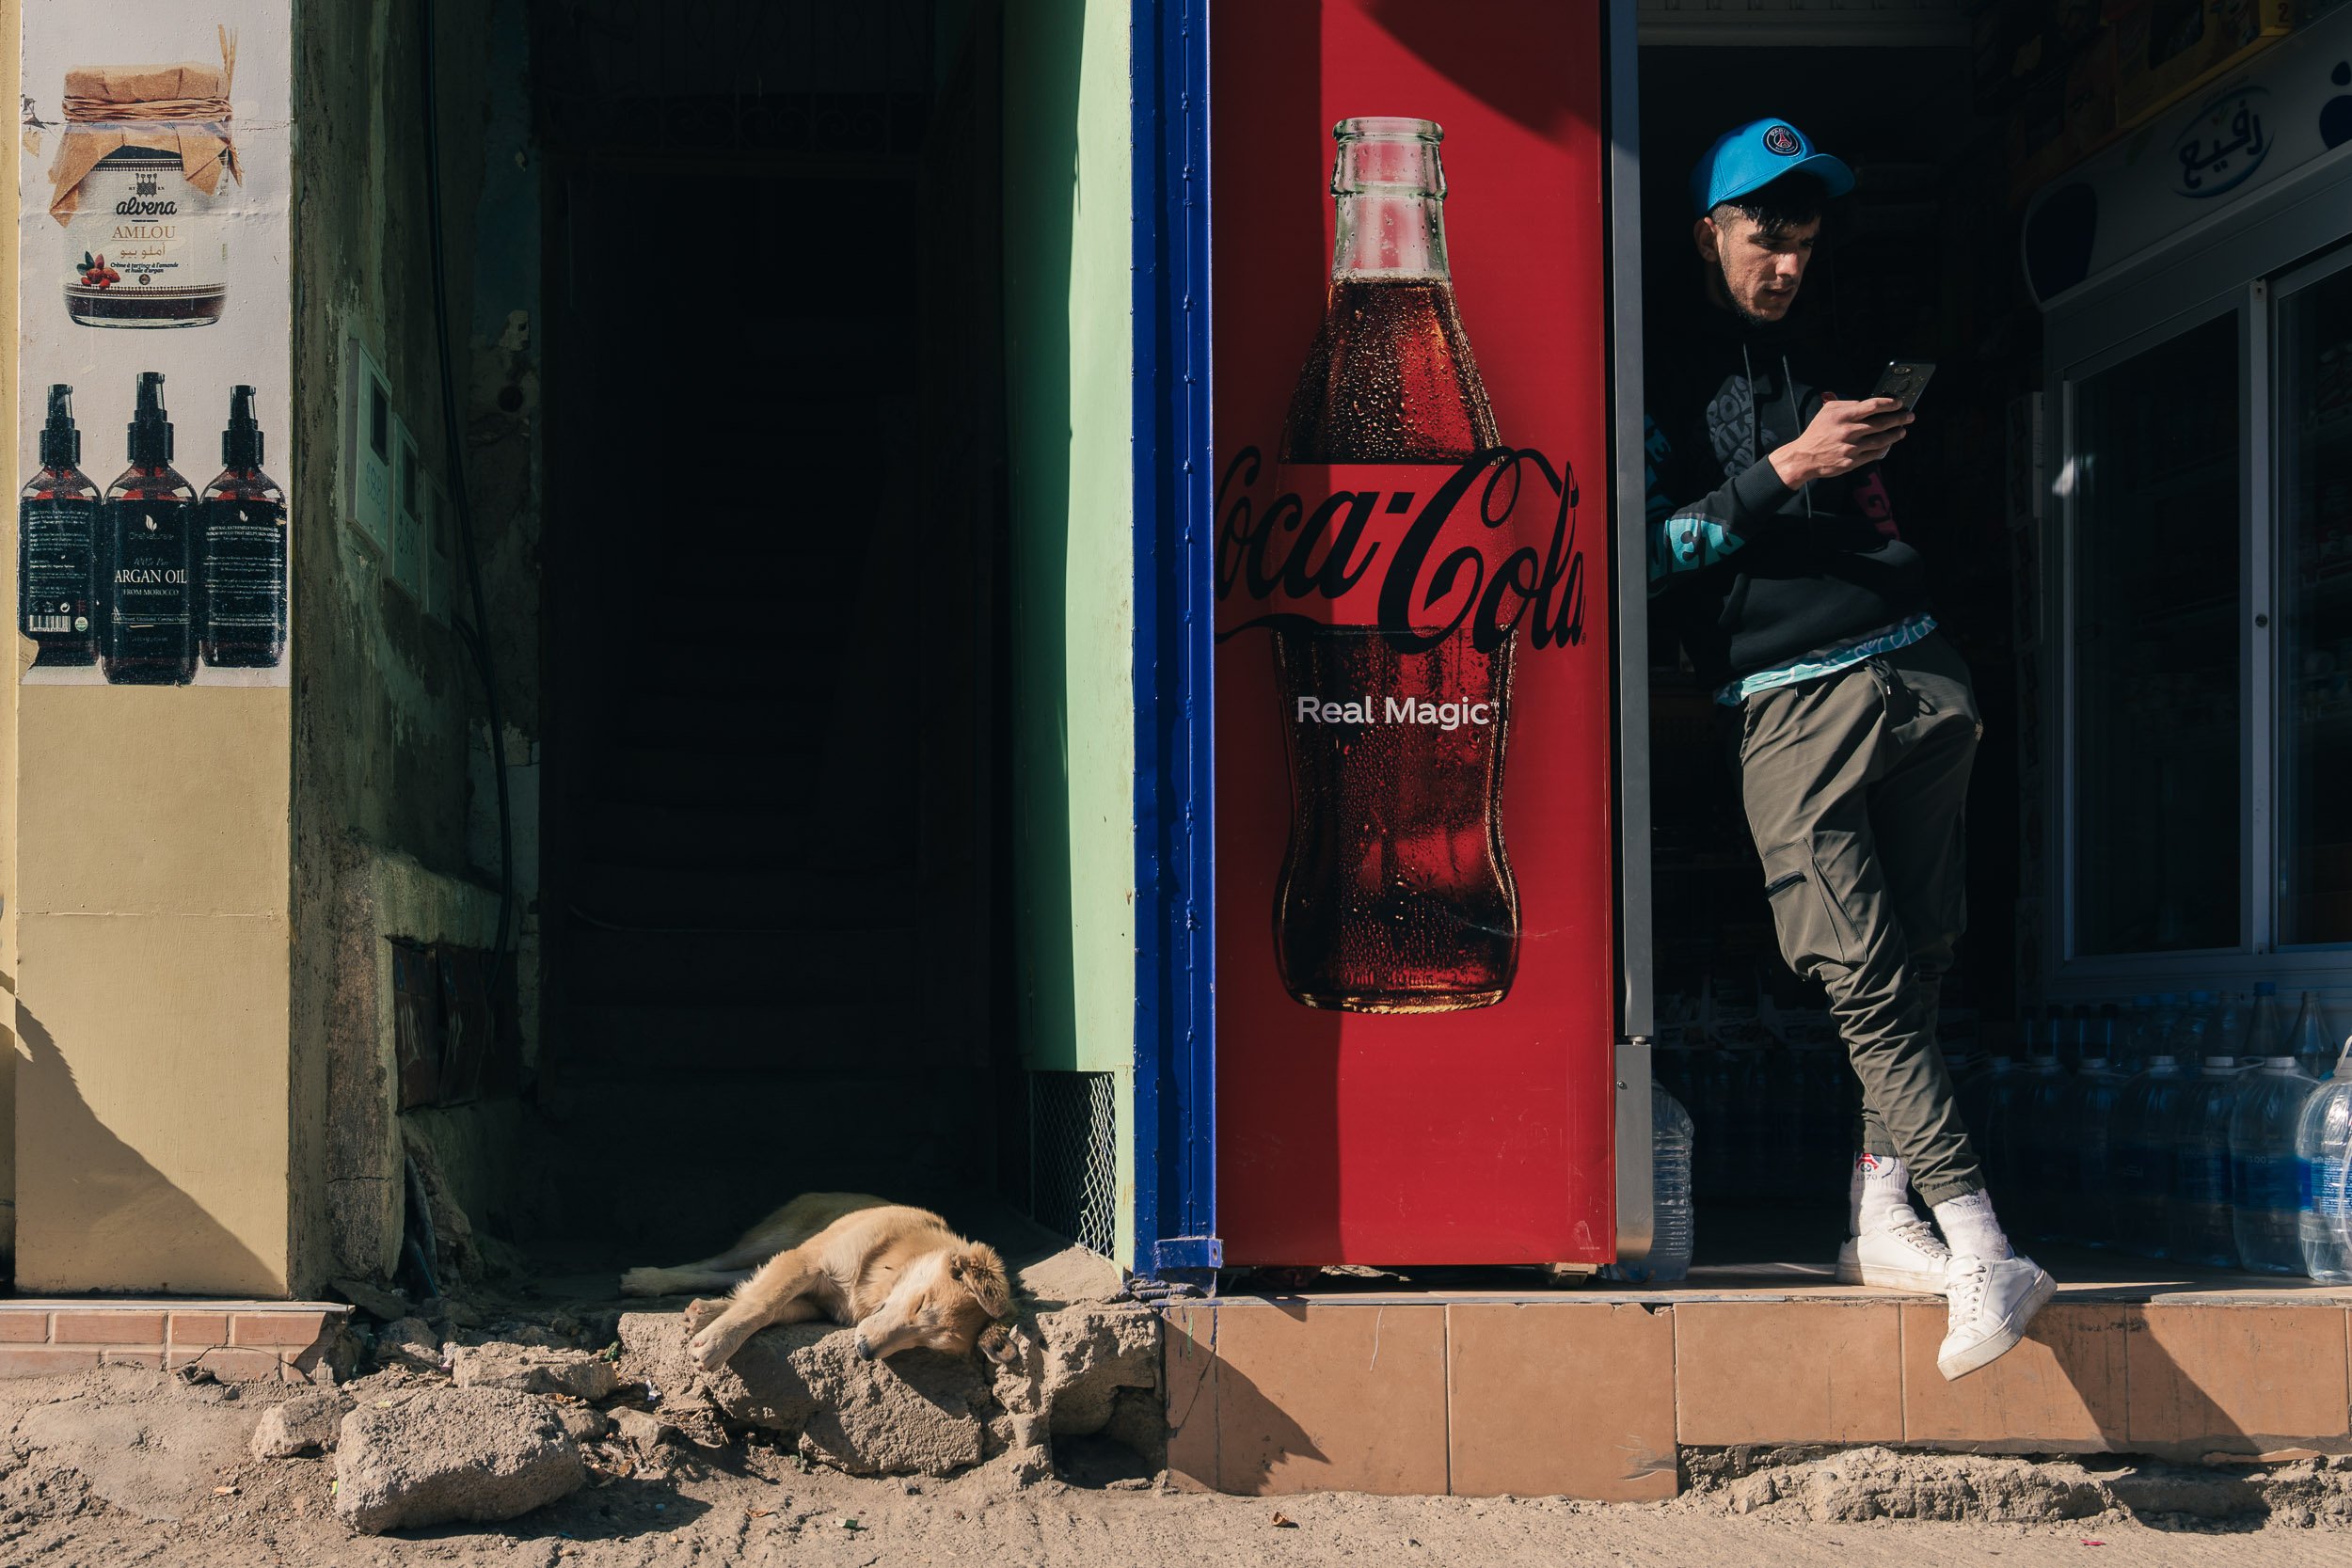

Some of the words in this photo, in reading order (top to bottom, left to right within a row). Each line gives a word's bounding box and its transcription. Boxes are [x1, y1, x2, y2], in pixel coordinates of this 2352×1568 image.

[2179, 98, 2263, 189] رفيع
[116, 196, 178, 215] alvena
[112, 226, 176, 240] AMLOU
[119, 247, 137, 259] بيو
[141, 242, 166, 260] أملو
[1214, 446, 1586, 655] Coca-Cola
[114, 569, 162, 583] ARGAN
[165, 568, 188, 584] OIL
[143, 588, 180, 596] MOROCCO
[1296, 696, 1374, 724] Real
